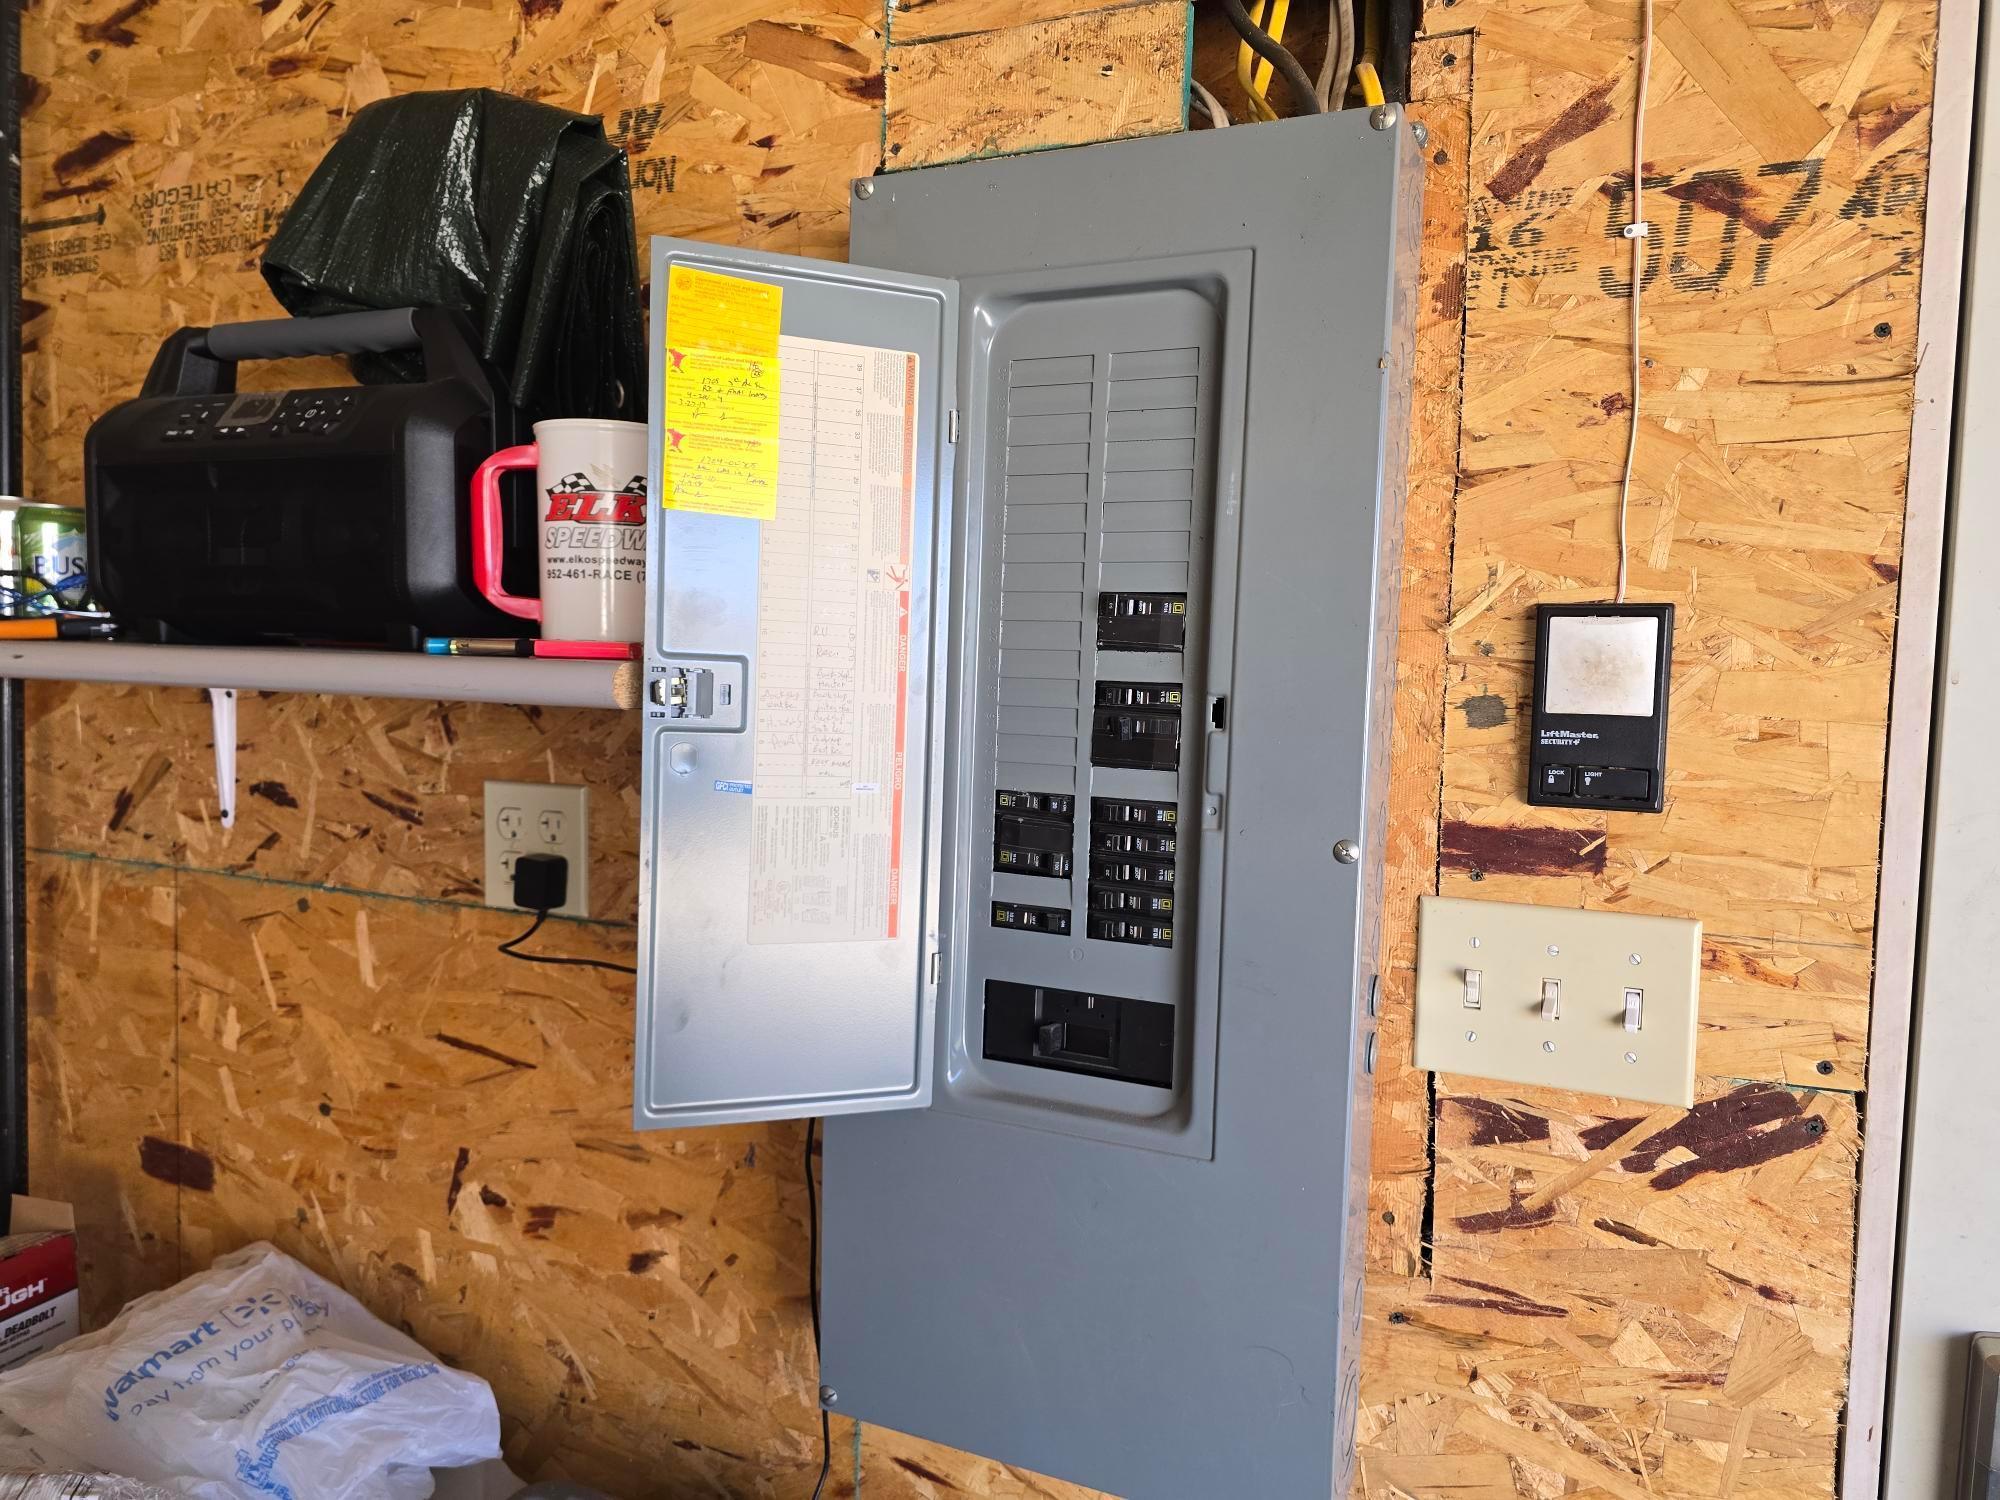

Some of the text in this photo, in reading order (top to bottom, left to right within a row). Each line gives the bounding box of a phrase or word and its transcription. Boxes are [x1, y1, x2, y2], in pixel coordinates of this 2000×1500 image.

[128, 179, 232, 212] CATEGORY
[906, 366, 915, 405] WARNING
[546, 526, 646, 551] SPEEDW
[547, 569, 632, 581] 952-461-RACE
[898, 634, 907, 672] DANGER
[894, 752, 903, 790] PELIGRO
[890, 869, 899, 905] DANGER
[4, 1306, 57, 1339] DEADBOLT
[225, 1323, 275, 1362] your
[360, 1380, 386, 1405] STORE
[385, 1373, 403, 1392] FOR
